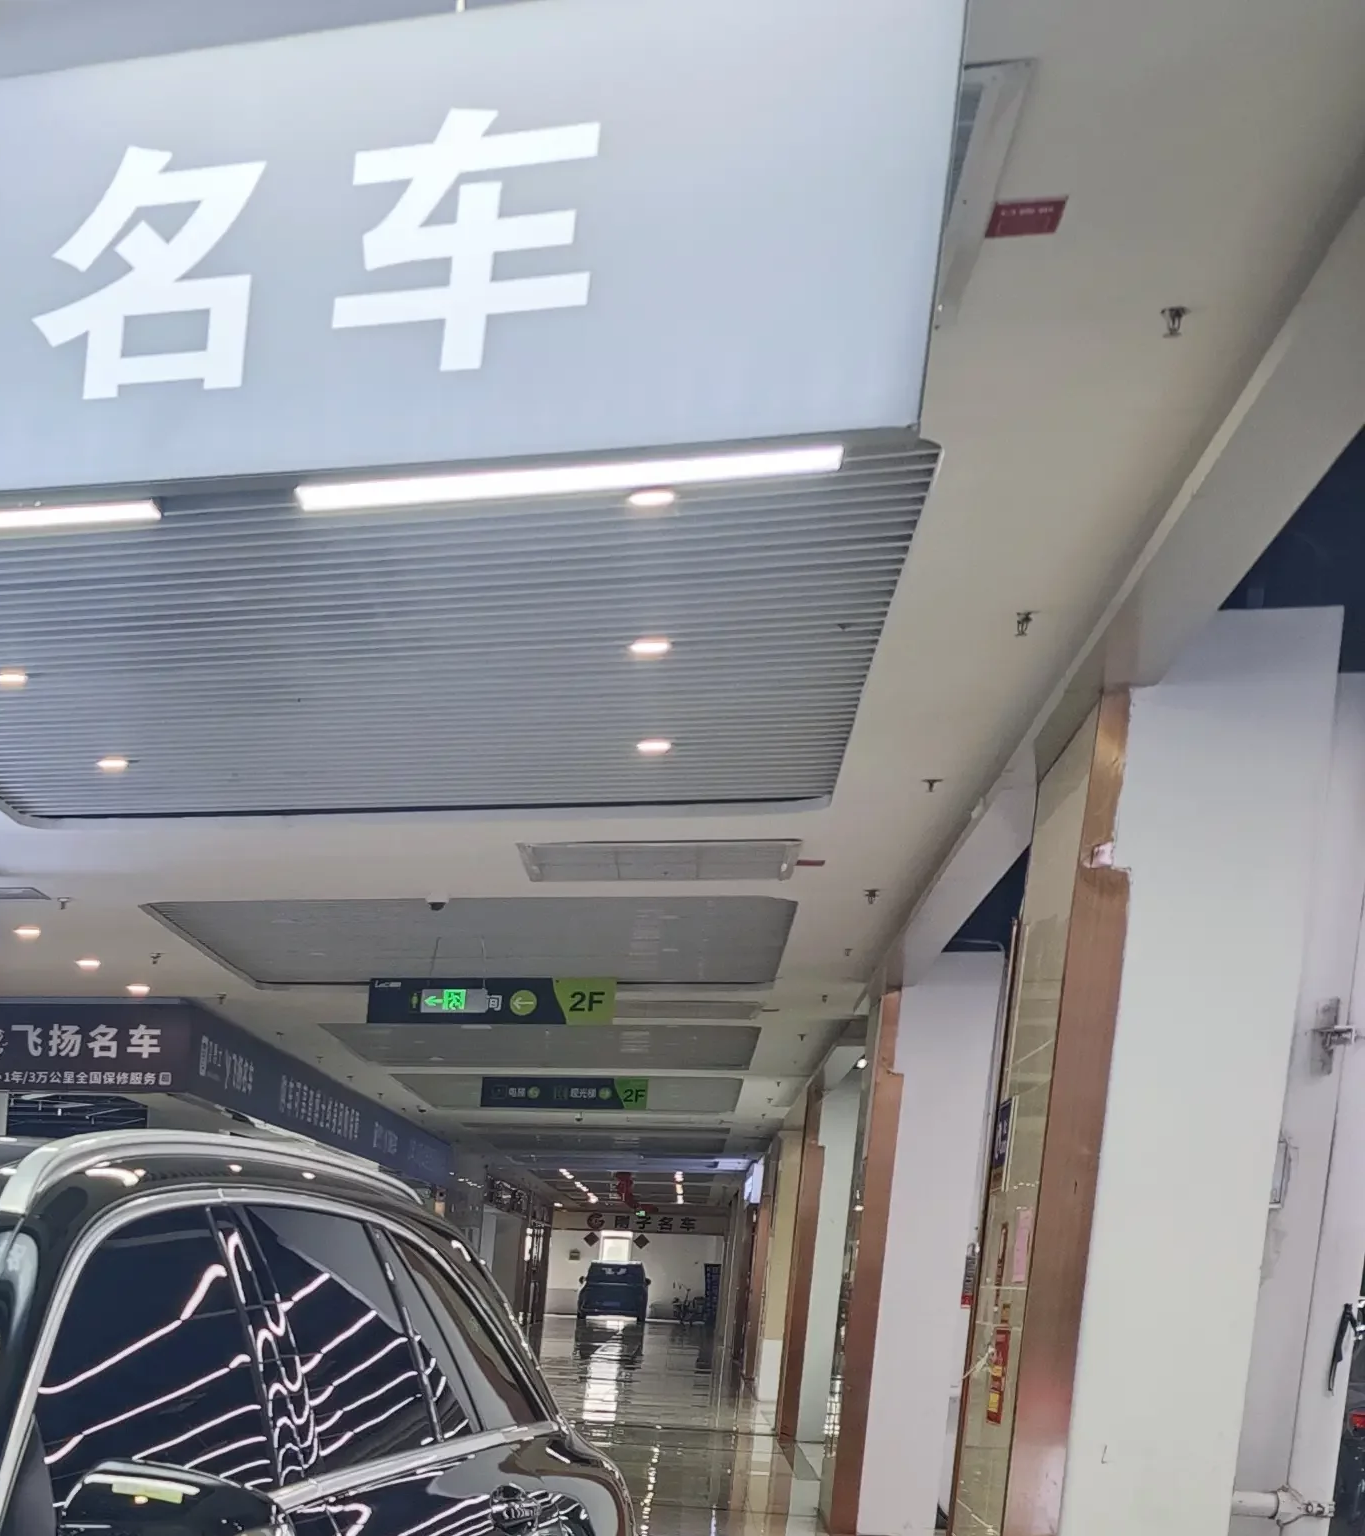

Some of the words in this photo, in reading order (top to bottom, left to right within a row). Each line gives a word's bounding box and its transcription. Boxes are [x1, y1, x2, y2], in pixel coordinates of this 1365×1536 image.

[569, 991, 606, 1012] 2F
[11, 1023, 162, 1060] 飞扬名车
[622, 1088, 647, 1103] 2F
